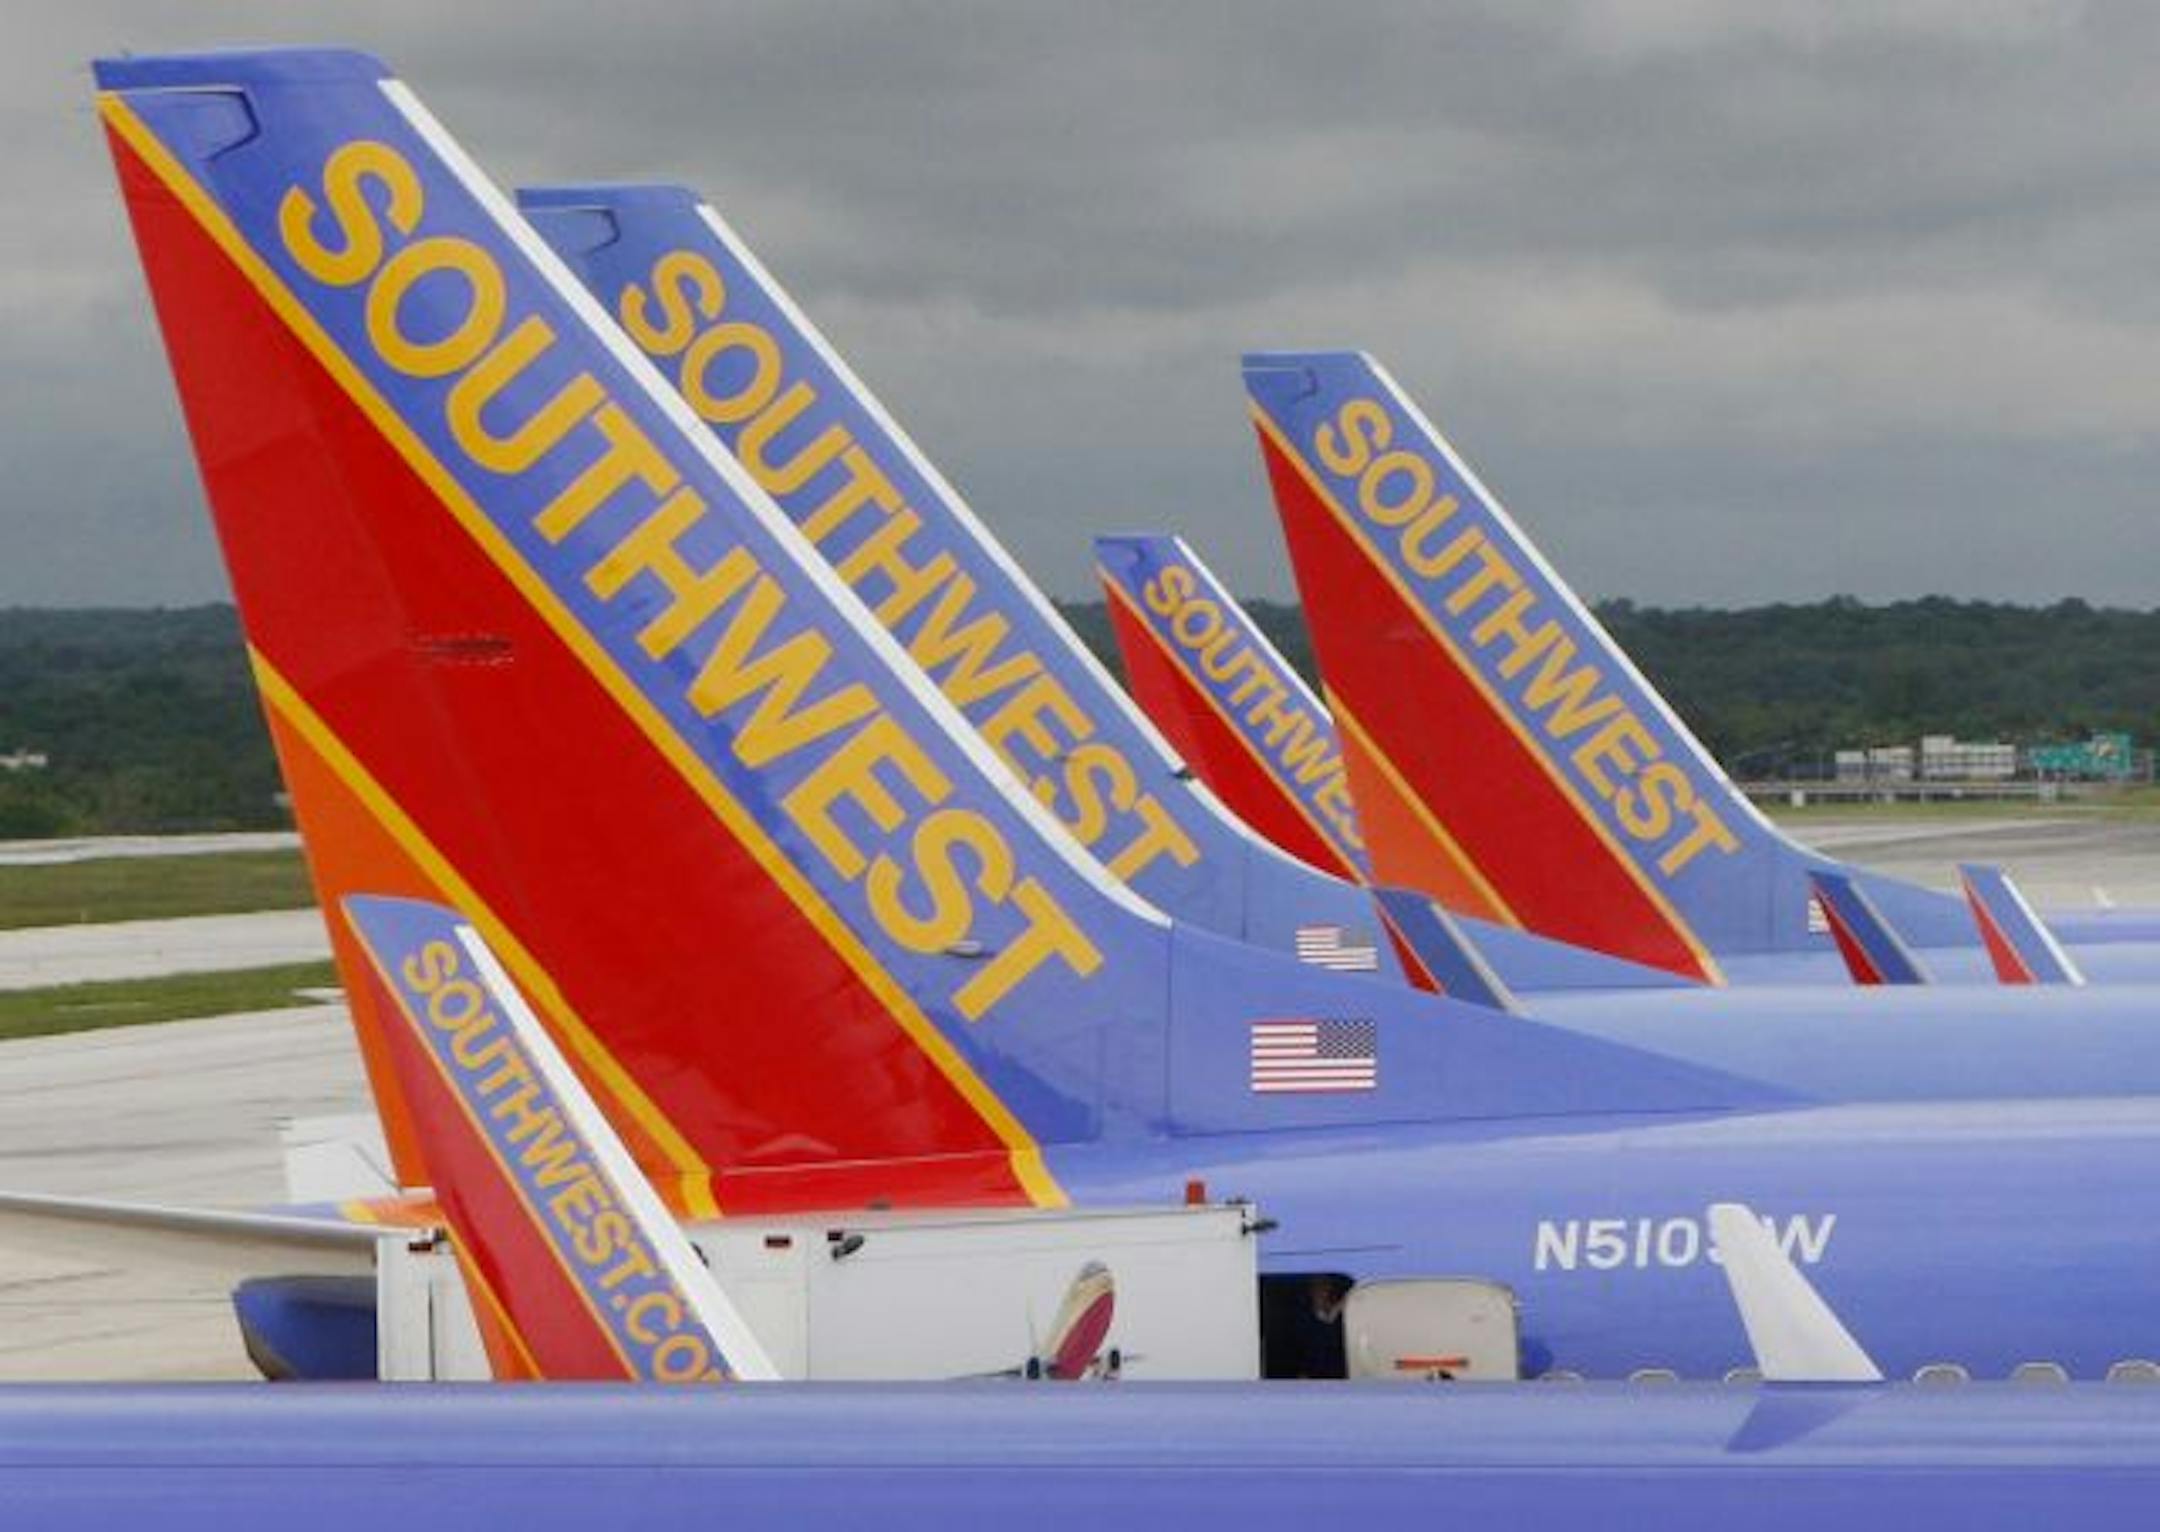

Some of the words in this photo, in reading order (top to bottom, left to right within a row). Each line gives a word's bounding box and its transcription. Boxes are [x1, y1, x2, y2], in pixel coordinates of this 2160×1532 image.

[279, 140, 1103, 1022] SOUTHWEST
[620, 250, 1199, 884] SOUTHWEST
[1144, 565, 1366, 850] SOUTHWE
[1315, 398, 1742, 877] SOUTHWEST
[404, 940, 742, 1381] SOUTHWEST.CO
[1534, 1214, 1837, 1270] N510W
